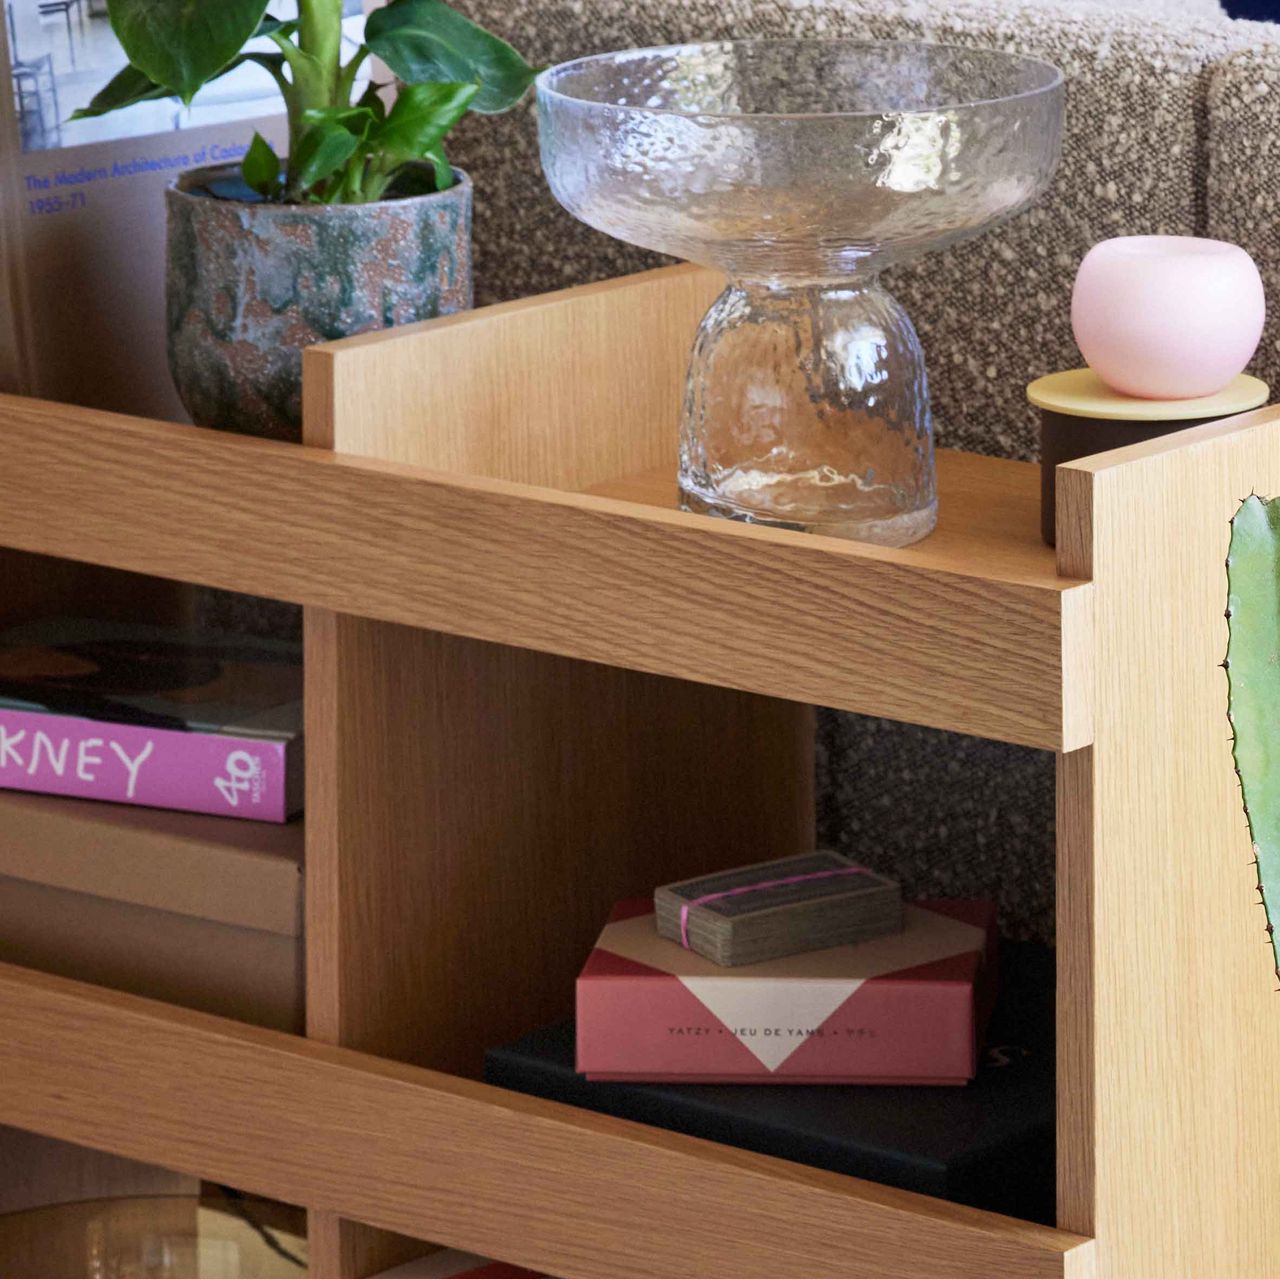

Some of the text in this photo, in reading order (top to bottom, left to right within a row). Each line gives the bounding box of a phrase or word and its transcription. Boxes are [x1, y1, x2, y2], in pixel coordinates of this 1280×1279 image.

[25, 175, 50, 191] The
[55, 168, 107, 188] Modern
[112, 155, 190, 179] Architecture
[0, 725, 154, 799] KNEY
[668, 1027, 711, 1036] YATZY
[733, 1027, 757, 1037] JEU
[764, 1027, 781, 1037] DE
